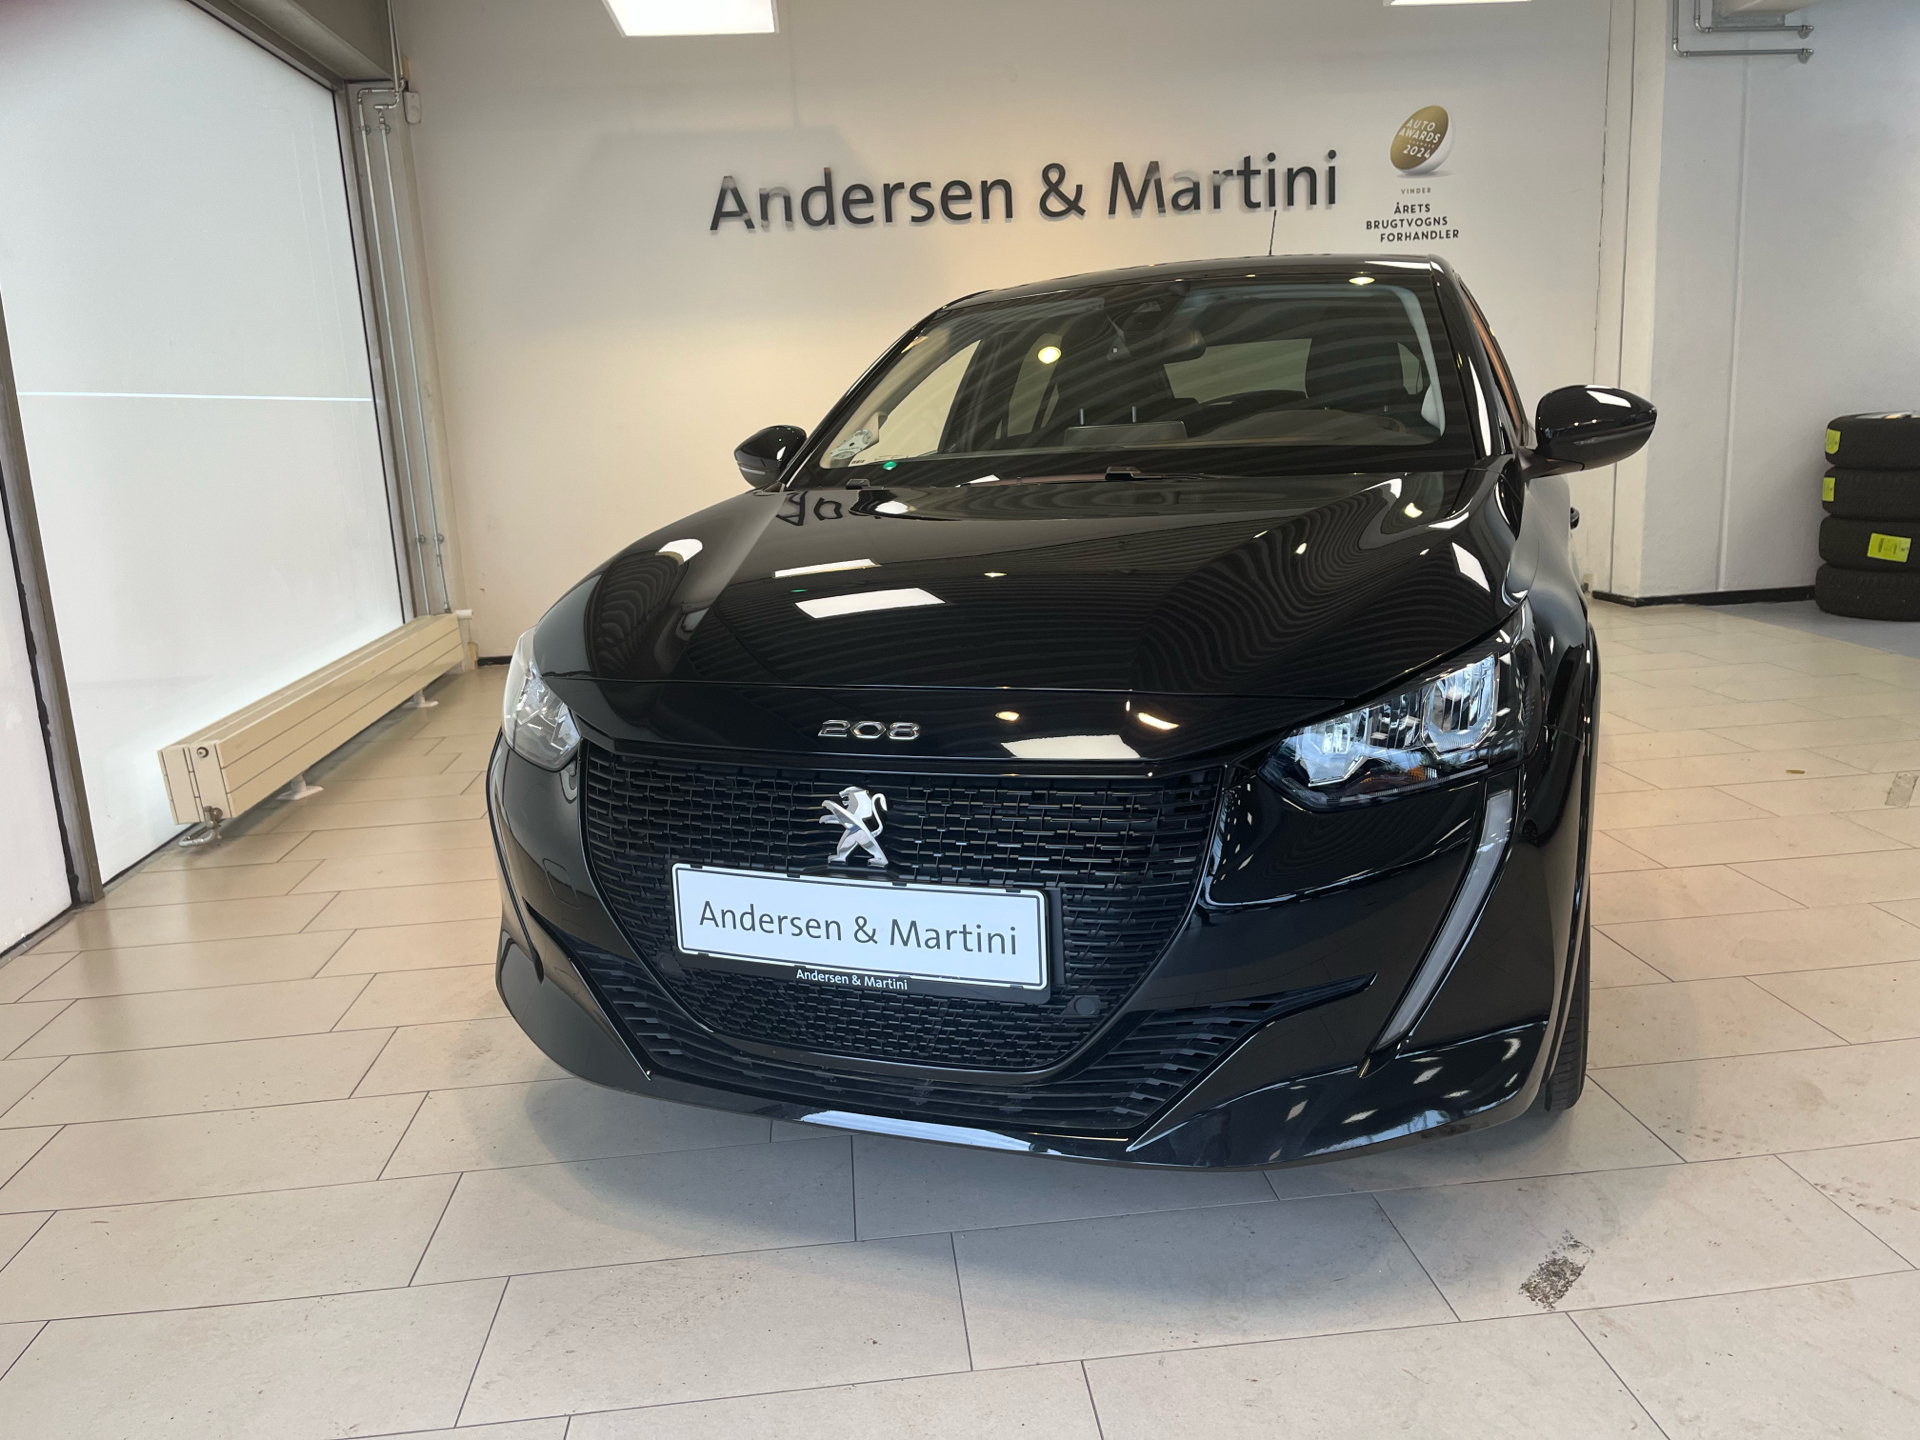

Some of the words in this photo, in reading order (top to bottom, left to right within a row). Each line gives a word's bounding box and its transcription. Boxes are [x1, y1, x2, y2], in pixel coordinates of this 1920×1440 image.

[1406, 119, 1435, 131] AUTO
[1398, 128, 1440, 143] AWARDS
[1403, 145, 1431, 158] 2024
[709, 166, 1014, 232] Andersen
[1038, 162, 1086, 220] &
[1107, 149, 1337, 216] Martini
[1400, 186, 1432, 195] VINDER
[1393, 201, 1431, 215] ÅRETS
[1366, 216, 1448, 230] BRUGTVOGNS
[1380, 229, 1459, 243] FORHANDLER
[817, 719, 920, 740] 208
[699, 900, 843, 941] Andersen
[853, 915, 879, 945] &
[889, 918, 1017, 955] Martini
[796, 969, 849, 985] Andersen
[851, 974, 862, 986] &
[864, 975, 908, 991] Martini
